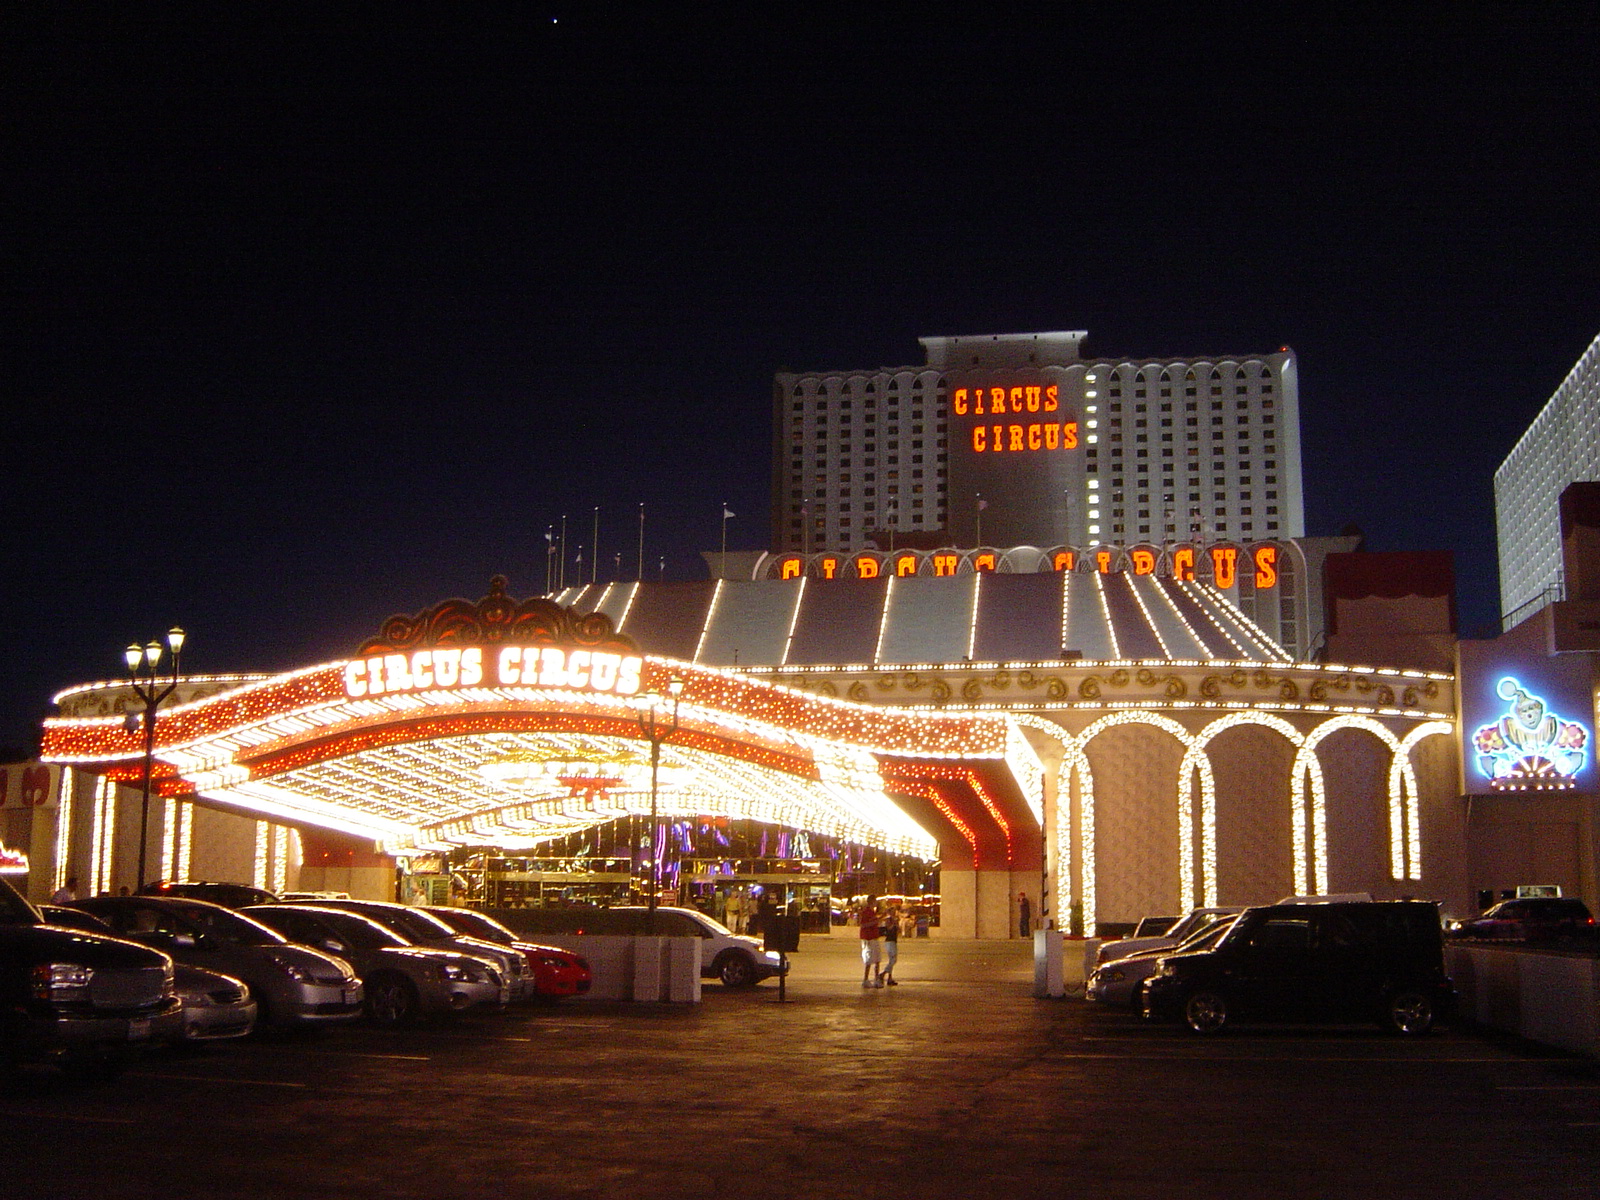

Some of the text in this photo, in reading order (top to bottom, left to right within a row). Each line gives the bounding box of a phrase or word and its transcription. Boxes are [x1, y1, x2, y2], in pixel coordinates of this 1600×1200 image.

[953, 385, 1059, 416] CIRCUS
[972, 422, 1079, 454] CIRCUS
[344, 646, 642, 697] CIRCUS CIRCUS
